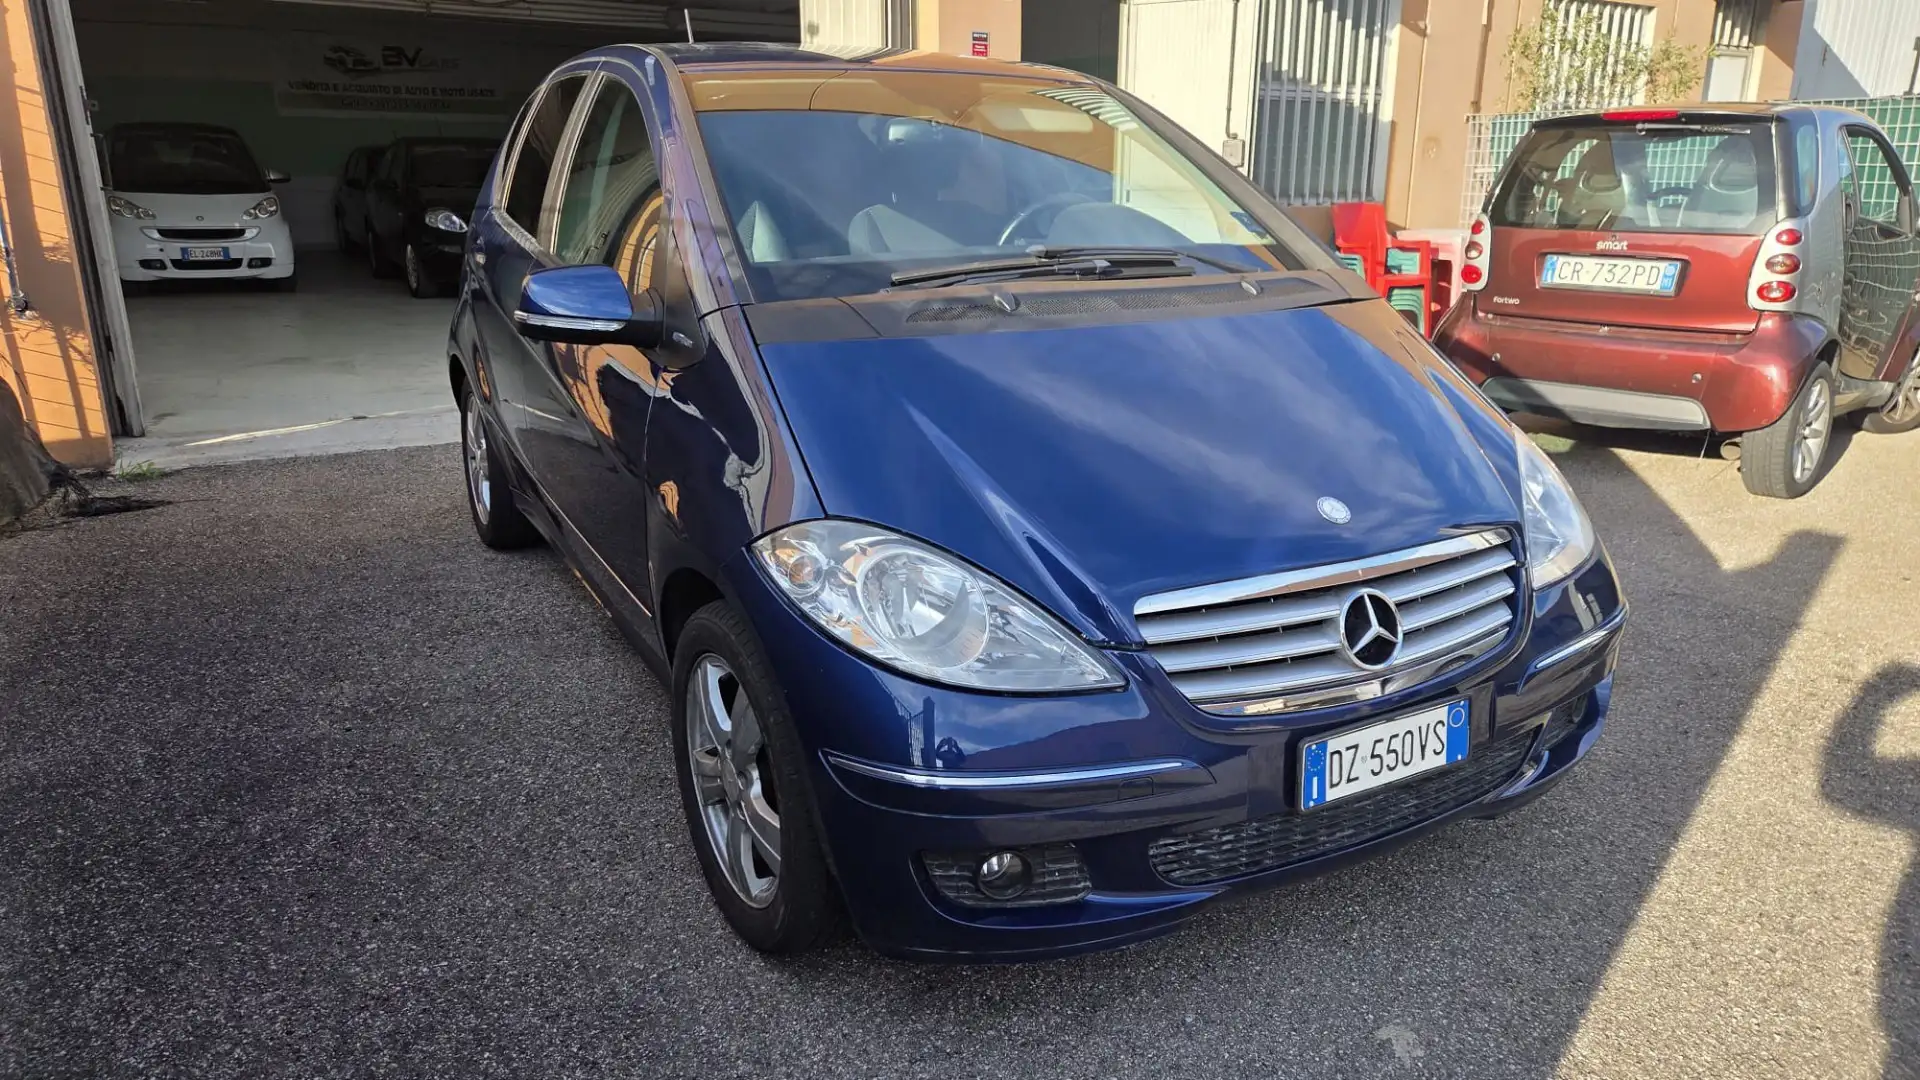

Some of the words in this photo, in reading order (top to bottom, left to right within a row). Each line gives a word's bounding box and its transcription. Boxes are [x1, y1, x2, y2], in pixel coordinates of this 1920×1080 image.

[1596, 240, 1629, 251] smart
[1558, 261, 1583, 282] CR
[1591, 262, 1660, 287] 732PD
[1329, 743, 1360, 789] DZ
[1370, 720, 1446, 777] 550VS
